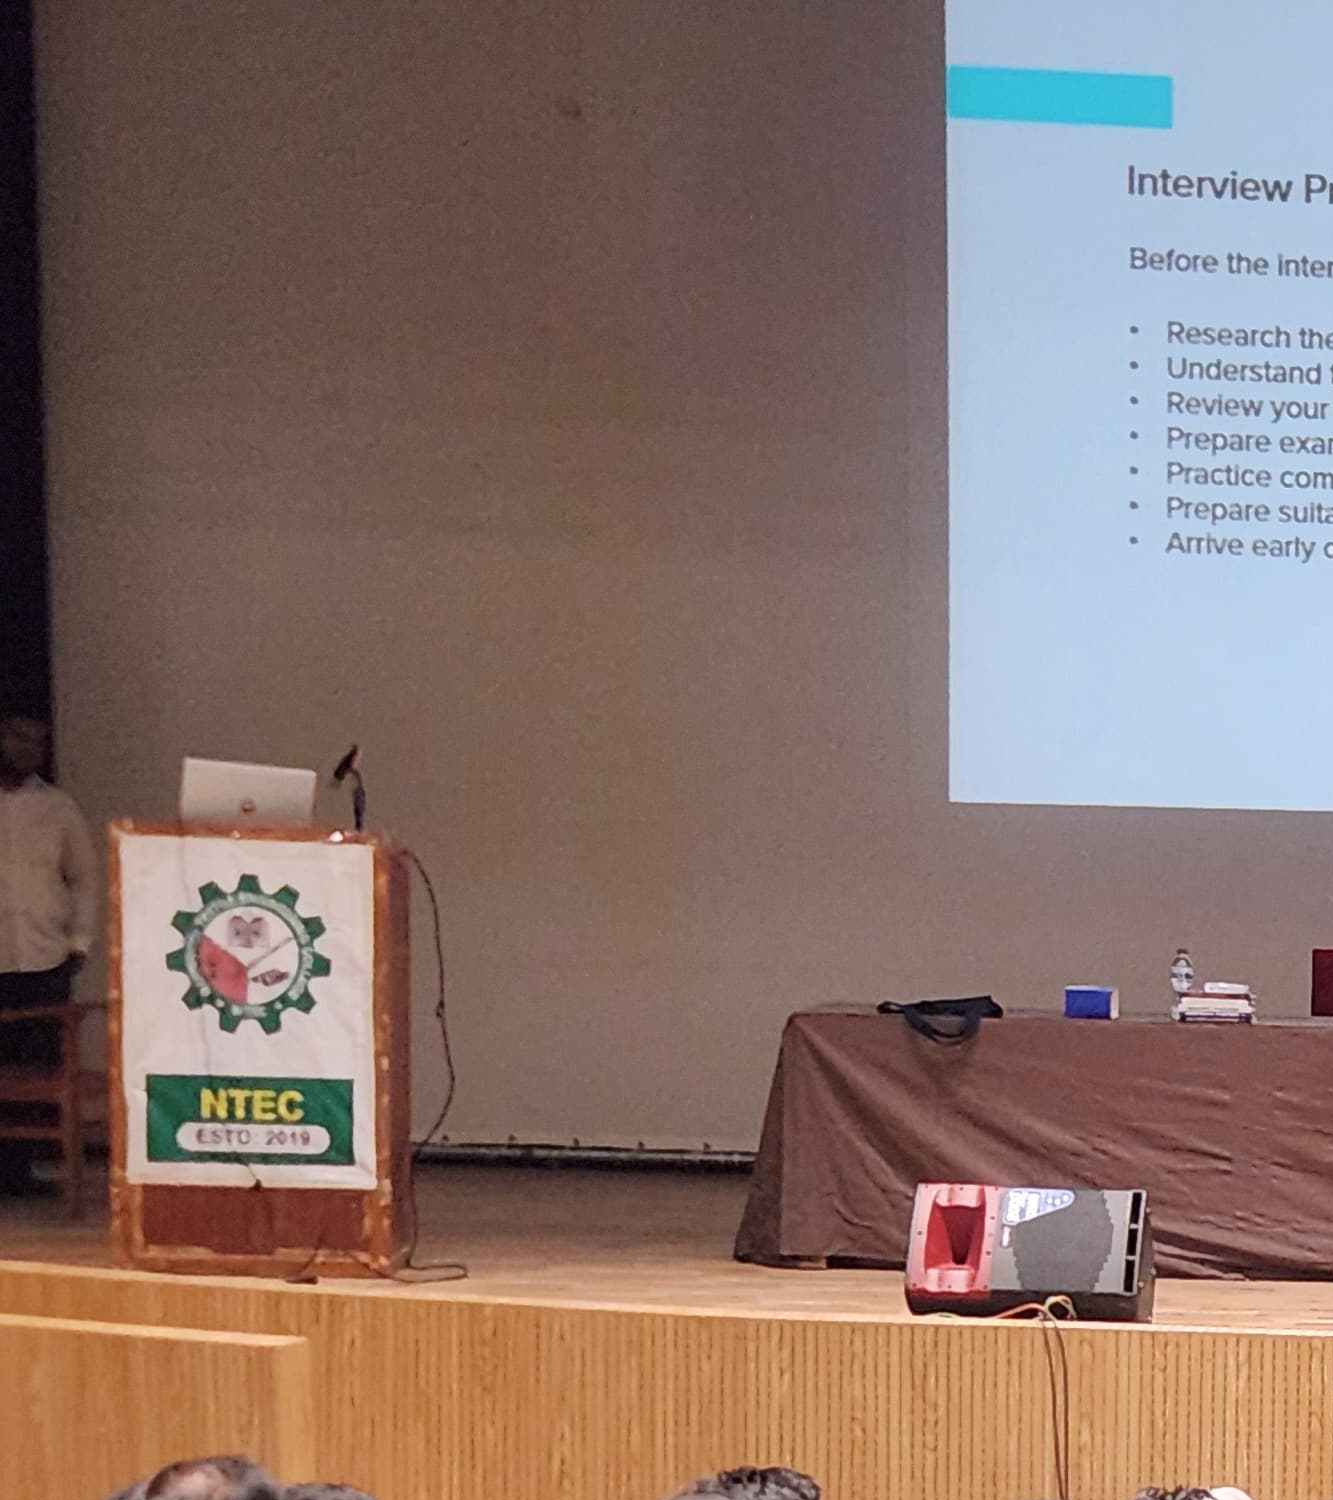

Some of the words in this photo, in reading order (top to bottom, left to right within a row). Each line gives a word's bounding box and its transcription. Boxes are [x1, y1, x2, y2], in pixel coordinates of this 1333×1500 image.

[1127, 164, 1294, 203] Interview
[1129, 246, 1219, 274] Before
[1226, 251, 1270, 276] the
[1167, 320, 1292, 350] Research
[1167, 356, 1323, 386] Understand
[1166, 391, 1265, 418] Review
[1269, 399, 1331, 424] your
[1166, 426, 1273, 457] Prepare
[1166, 461, 1273, 489] Practice
[1166, 496, 1272, 527] Prepare
[1165, 531, 1245, 556] Arrive
[1251, 535, 1317, 565] early
[200, 1087, 306, 1122] NTEC
[264, 1129, 311, 1147] 2019
